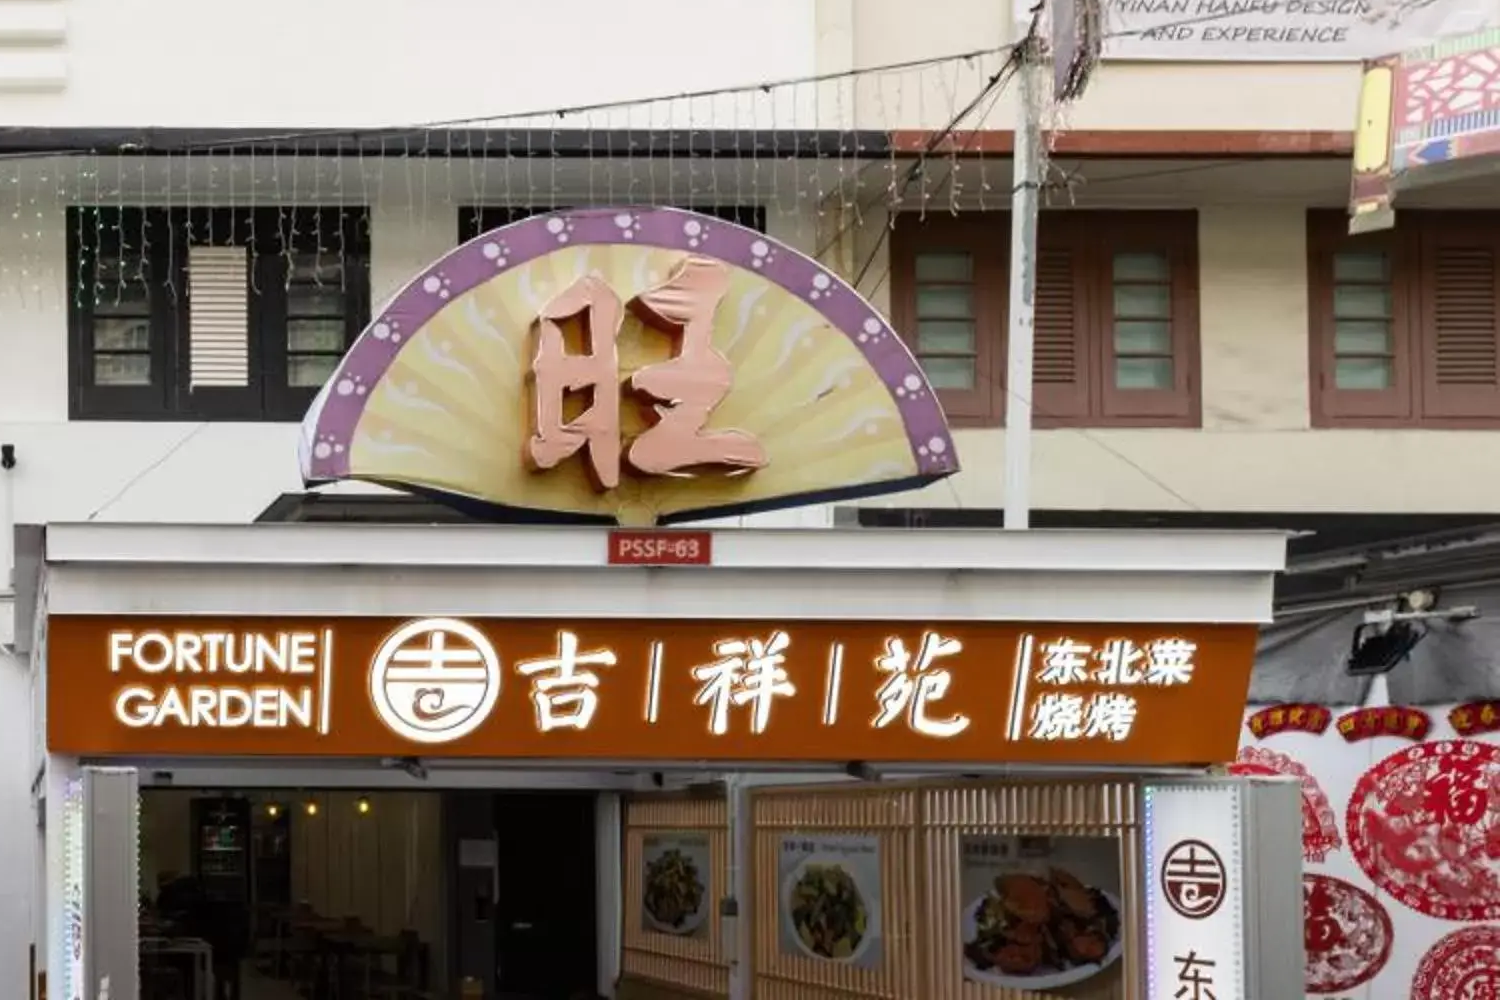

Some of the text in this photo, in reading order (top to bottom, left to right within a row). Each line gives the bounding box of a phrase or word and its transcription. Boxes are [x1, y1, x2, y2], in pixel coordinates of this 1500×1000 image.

[1140, 24, 1349, 42] AND EXPERIENCE
[522, 255, 768, 492] 旺
[109, 631, 316, 673] FORTUNE
[1036, 637, 1197, 685] 东北菜
[114, 686, 312, 728] GARDEN
[1031, 692, 1137, 741] 烧烤
